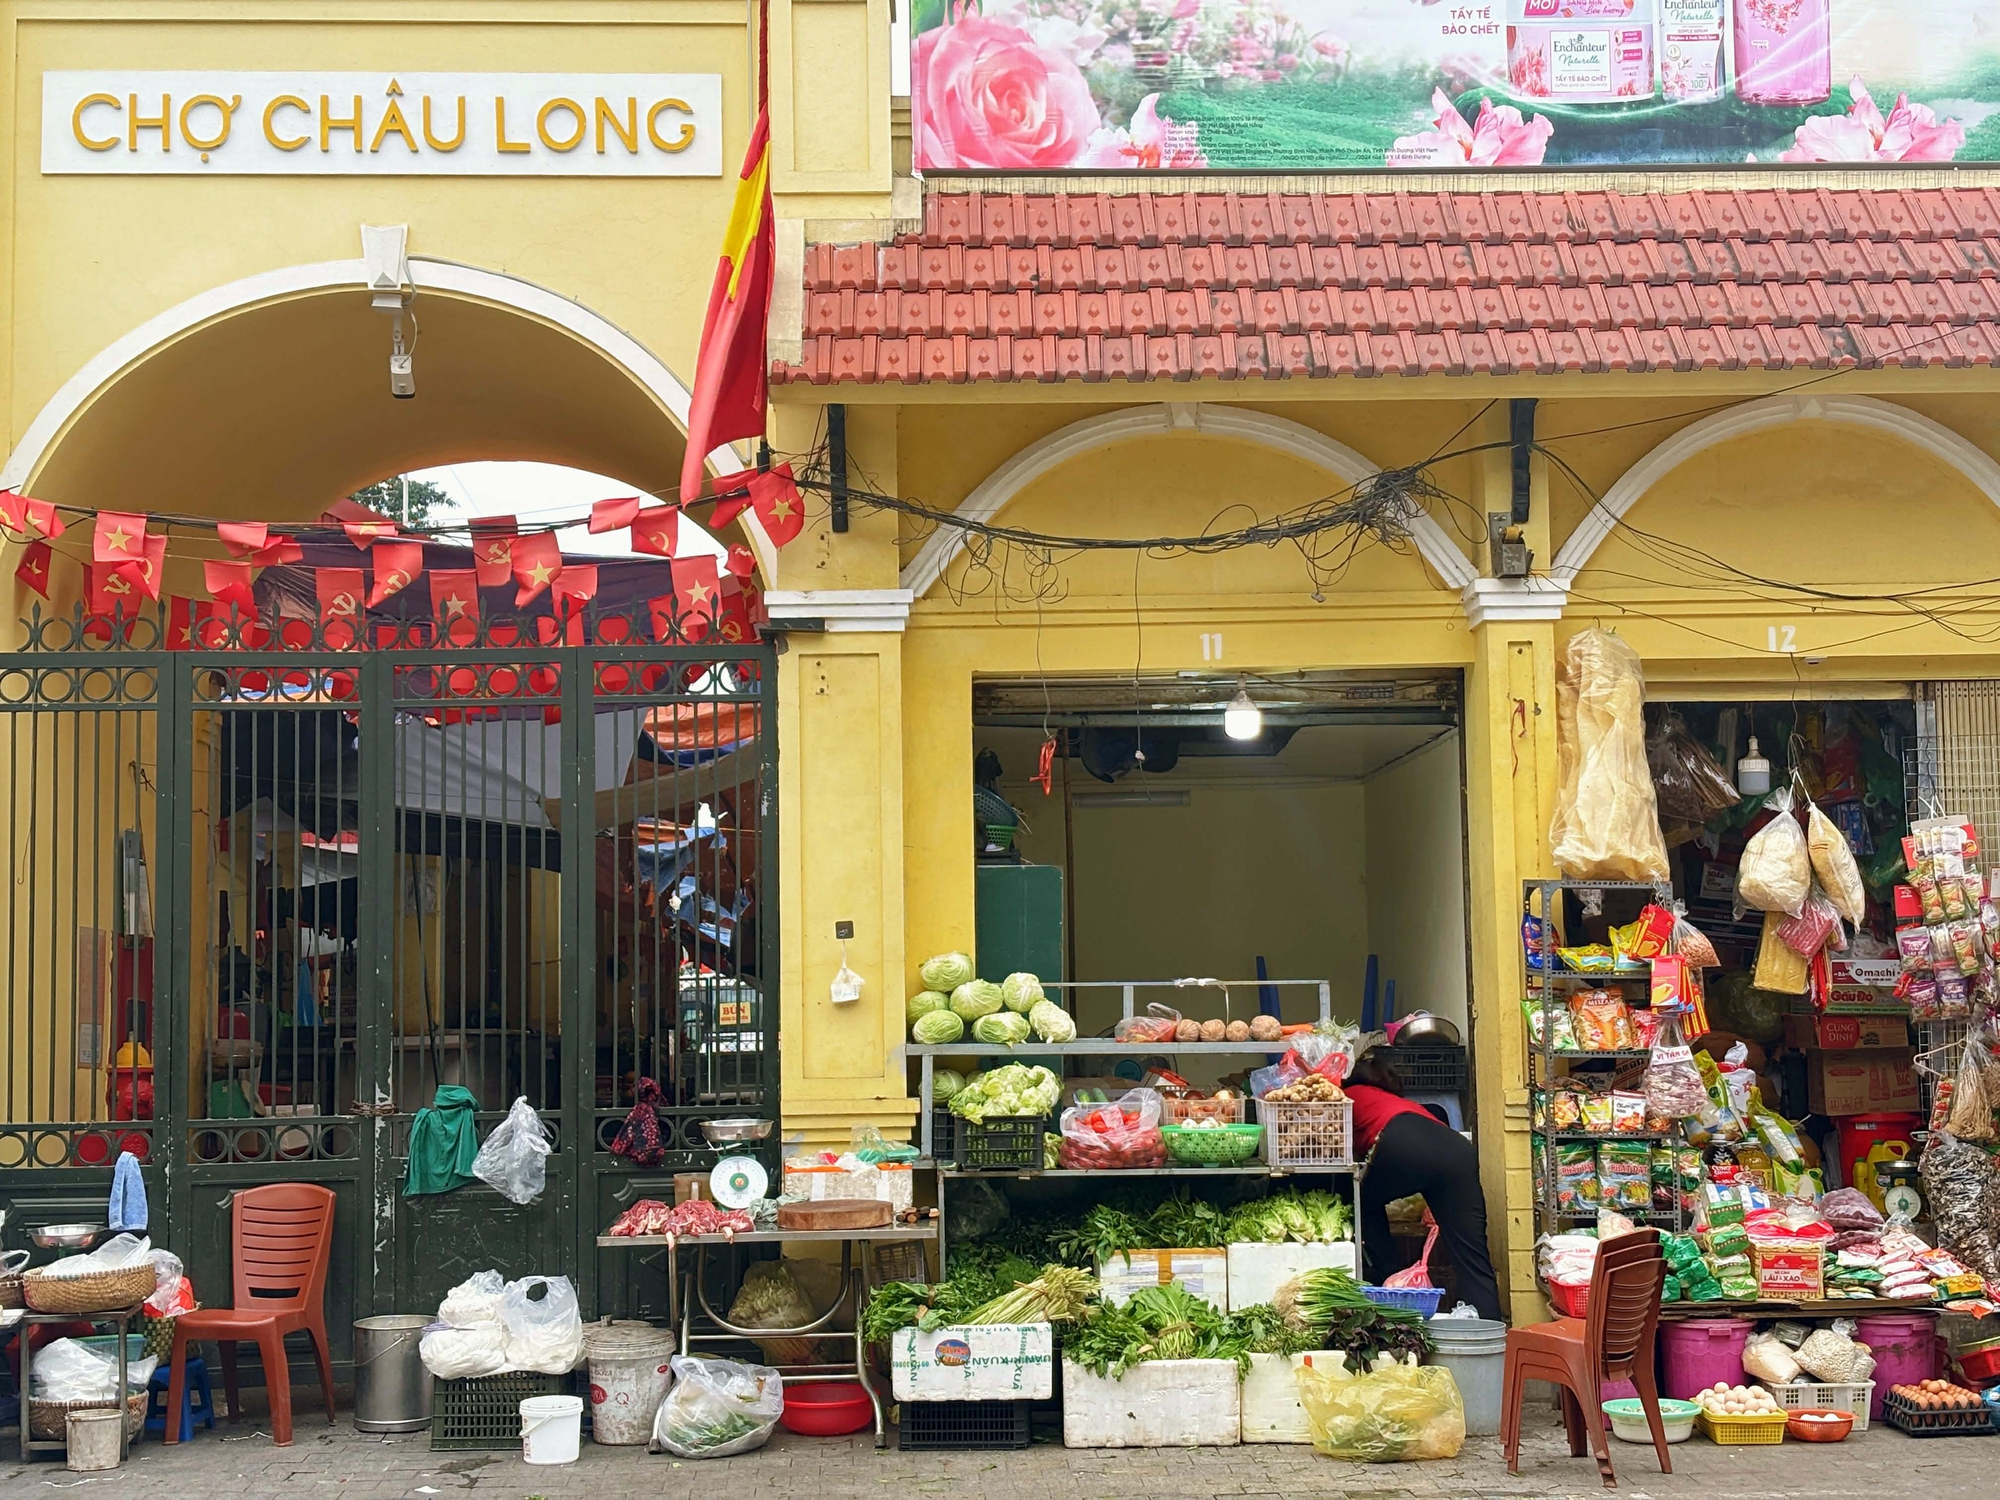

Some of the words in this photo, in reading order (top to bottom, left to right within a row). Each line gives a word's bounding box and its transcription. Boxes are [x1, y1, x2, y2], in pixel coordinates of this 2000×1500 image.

[1450, 6, 1473, 20] TẨY
[1476, 6, 1490, 19] TẾ
[1670, 10, 1714, 22] Naturelle
[1442, 24, 1467, 34] BÀO
[1470, 22, 1500, 34] CHẾT
[1554, 38, 1607, 52] Enchanteur
[1558, 54, 1600, 66] Naturelle
[1555, 74, 1568, 82] TẨY
[1568, 74, 1576, 82] TẾ
[1576, 74, 1590, 82] BÀO
[1590, 74, 1608, 82] CHẾT
[72, 93, 241, 163] CHỢ
[262, 78, 466, 153] CHÂU
[495, 96, 696, 154] LONG
[1768, 625, 1797, 652] 12
[1199, 633, 1222, 661] 11
[1855, 968, 1895, 976] Omachi
[1830, 990, 1856, 1002] Gấu
[1826, 1023, 1854, 1032] CUNG
